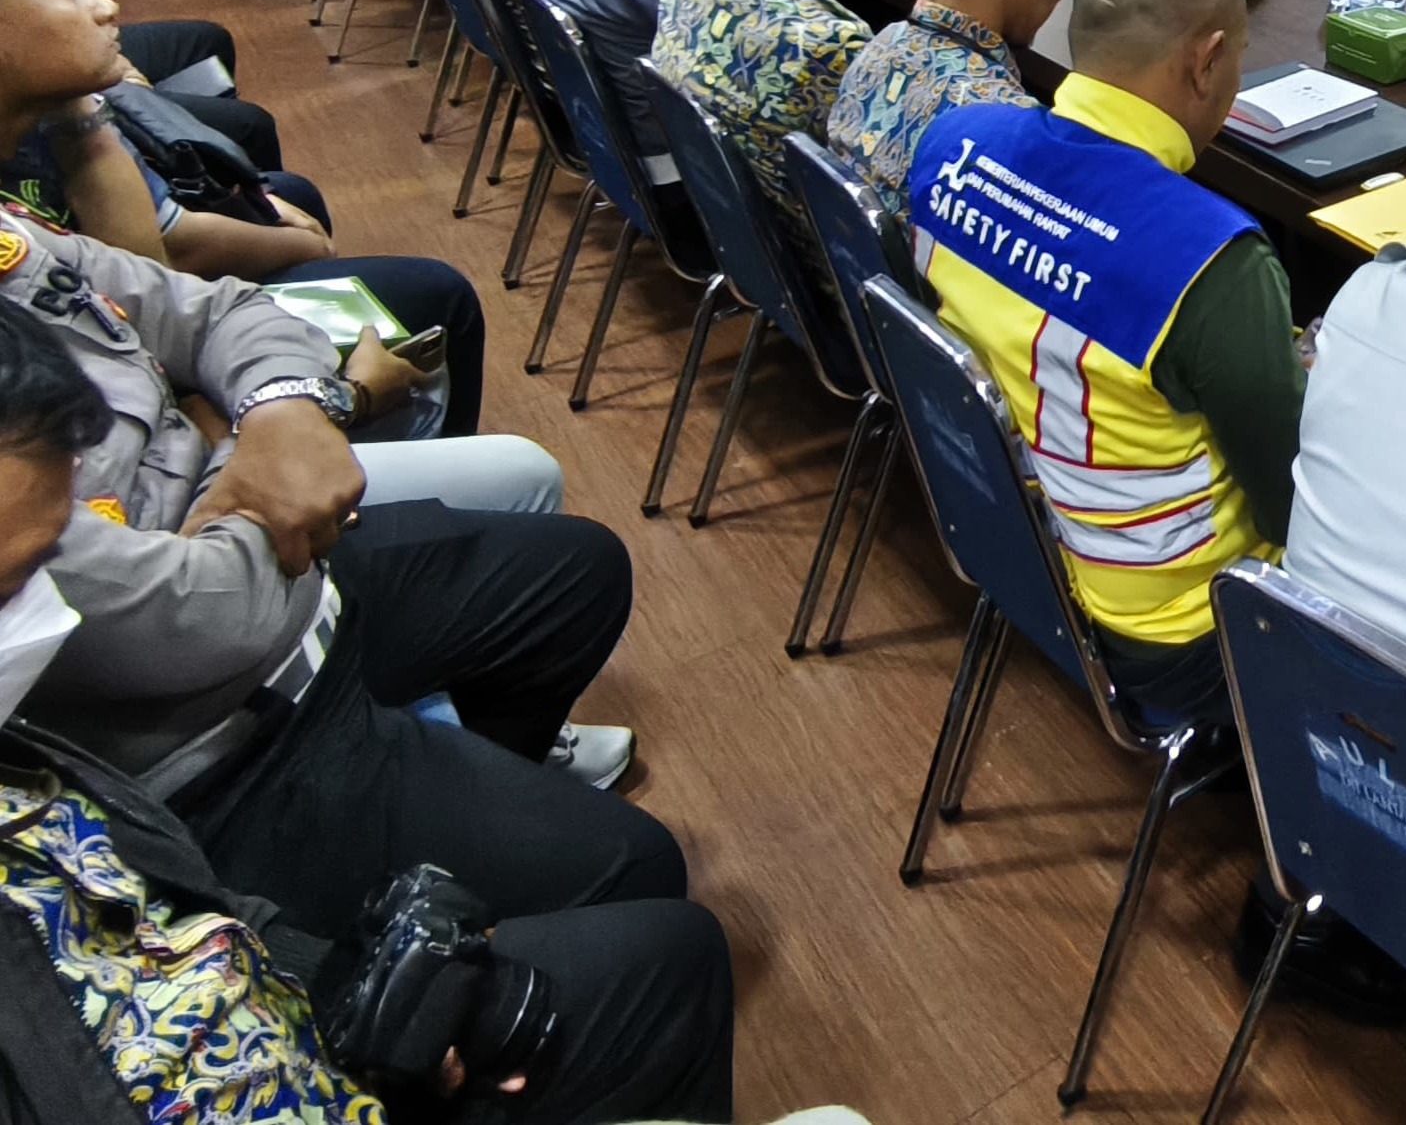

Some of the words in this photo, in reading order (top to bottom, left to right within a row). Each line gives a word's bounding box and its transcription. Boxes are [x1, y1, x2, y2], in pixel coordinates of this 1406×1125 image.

[929, 183, 1012, 255] SAFETY
[1008, 237, 1092, 302] FIRST
[1033, 212, 1073, 240] RAKYAT
